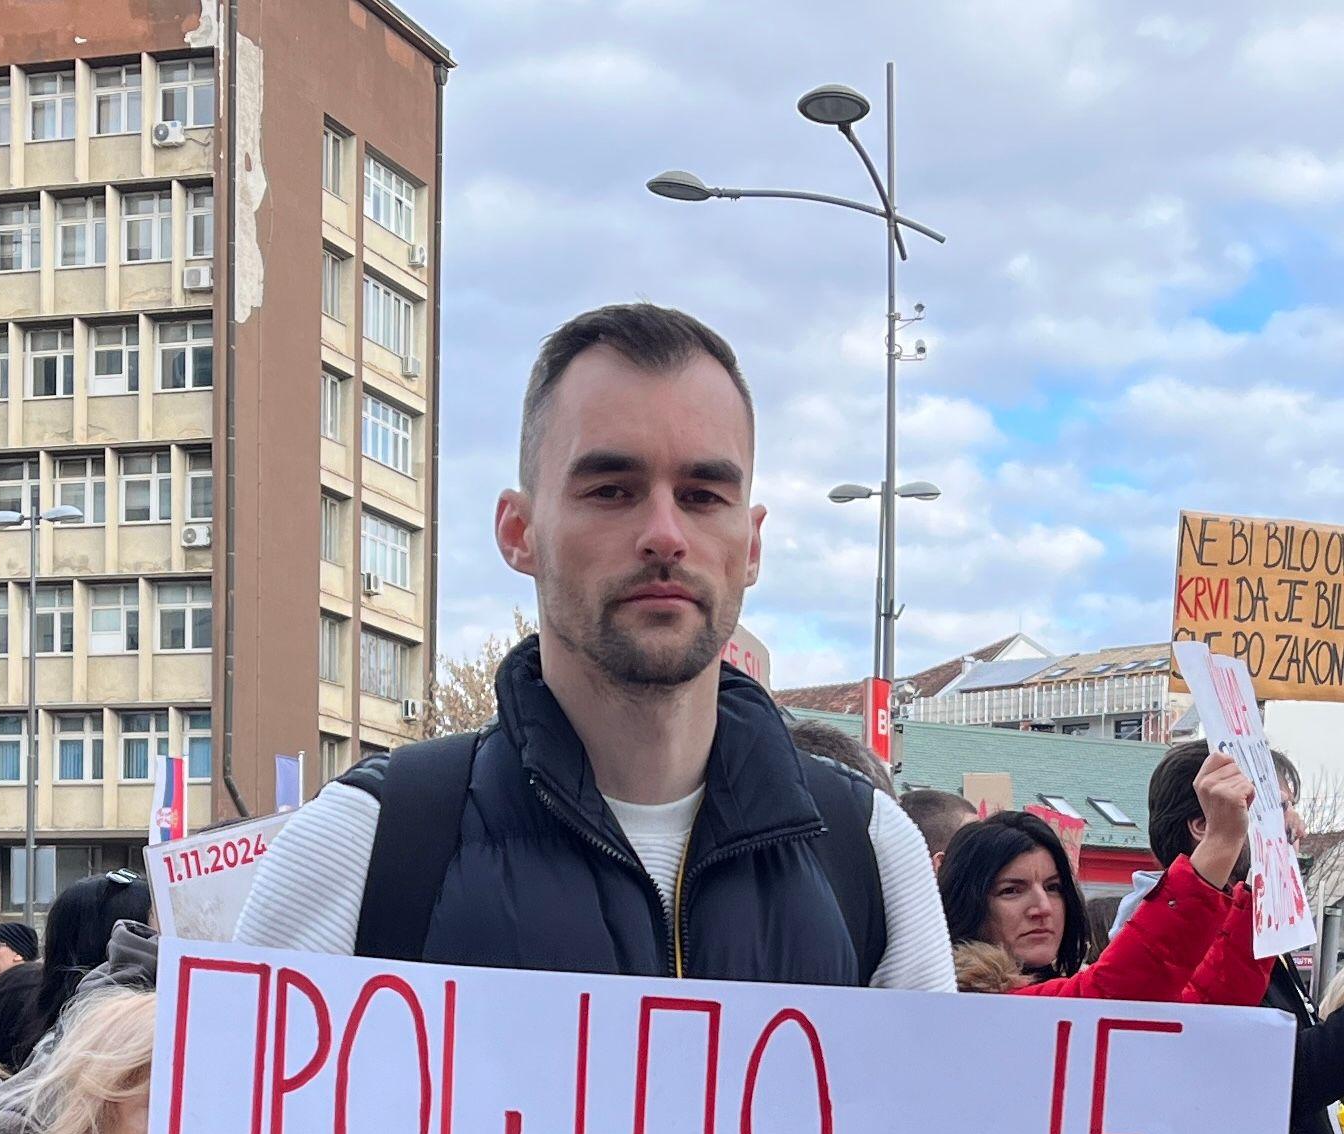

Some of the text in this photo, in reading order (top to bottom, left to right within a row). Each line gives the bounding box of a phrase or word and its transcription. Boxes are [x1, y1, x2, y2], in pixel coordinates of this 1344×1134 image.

[1179, 515, 1220, 567] NE
[1228, 519, 1254, 566] BI
[1264, 522, 1320, 573] BILO
[1175, 575, 1230, 622] KRVI
[1234, 576, 1269, 624] DA
[1274, 578, 1309, 624] JE
[1233, 631, 1265, 677] PO
[163, 833, 268, 884] 1.11.2024
